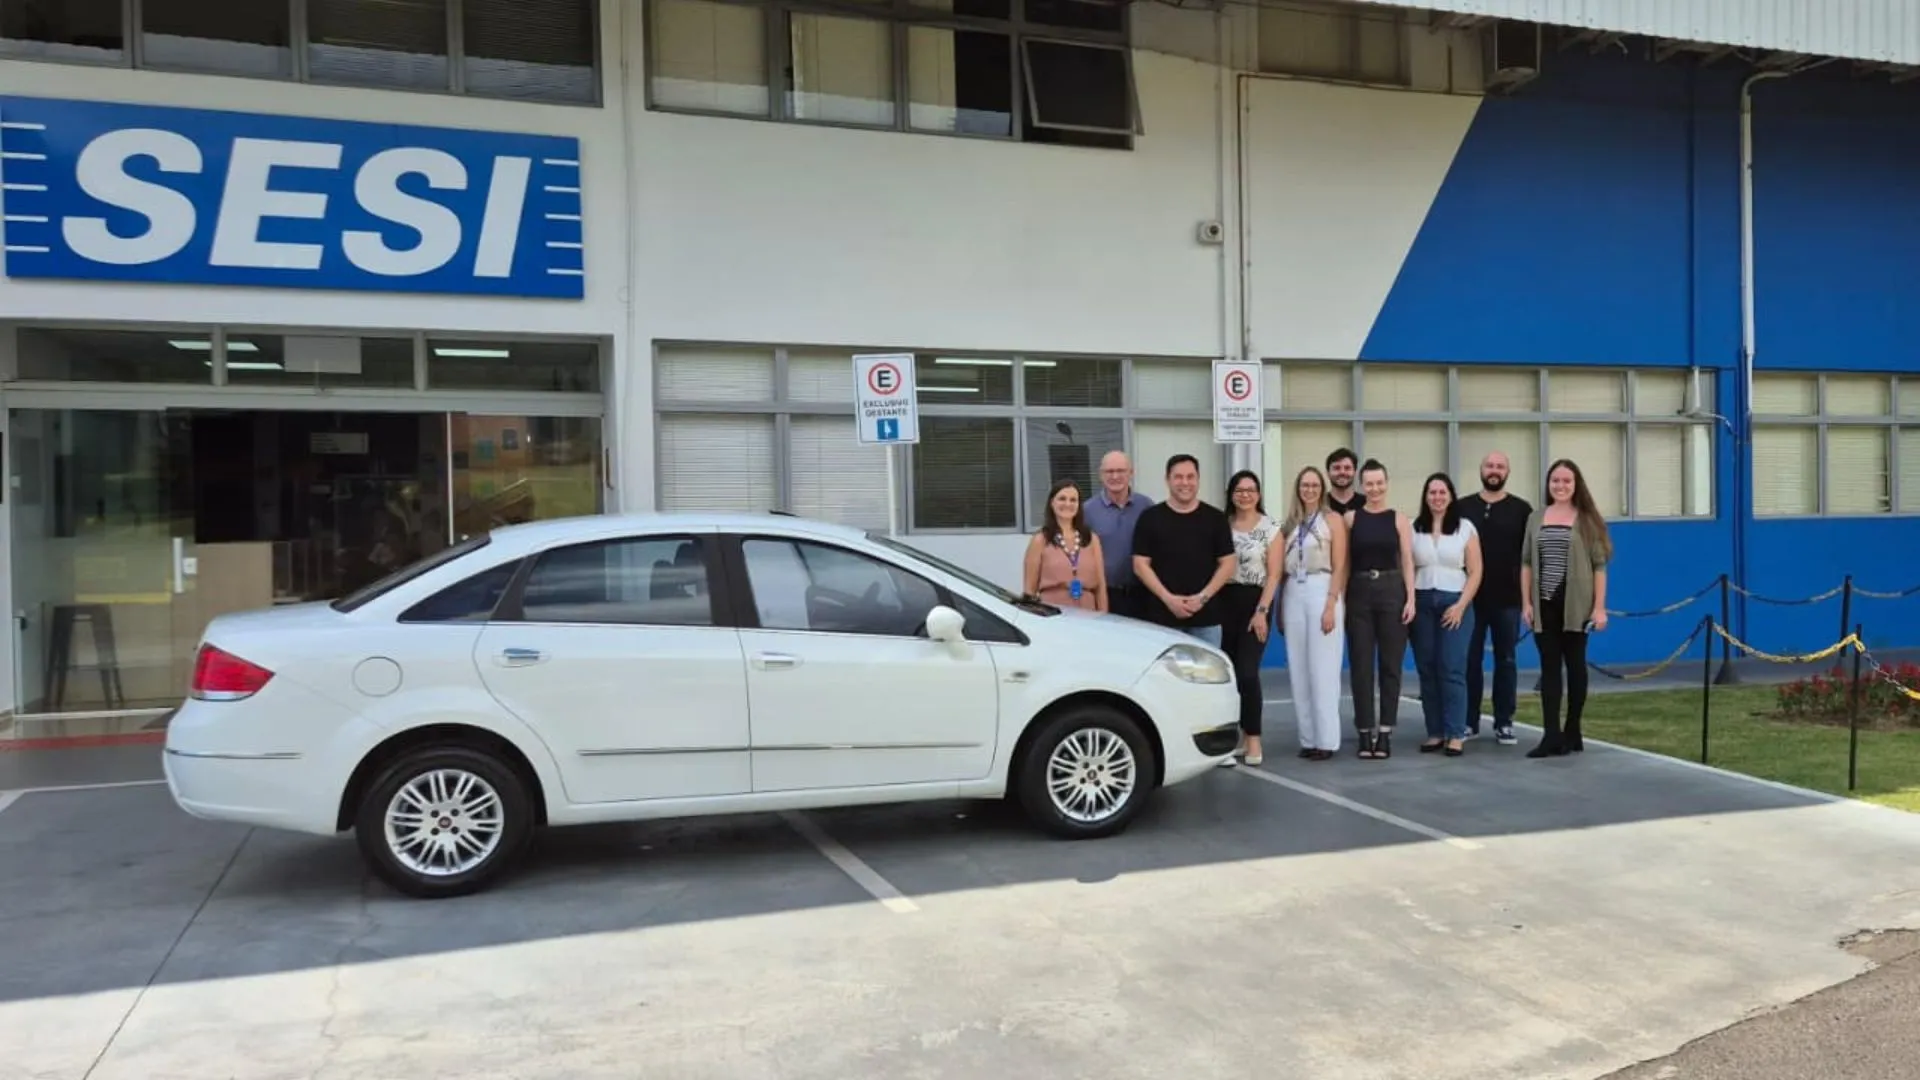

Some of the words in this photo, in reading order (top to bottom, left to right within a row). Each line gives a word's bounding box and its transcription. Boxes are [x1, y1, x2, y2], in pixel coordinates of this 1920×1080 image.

[62, 128, 532, 277] SESI
[877, 370, 892, 387] E
[1232, 377, 1243, 394] E
